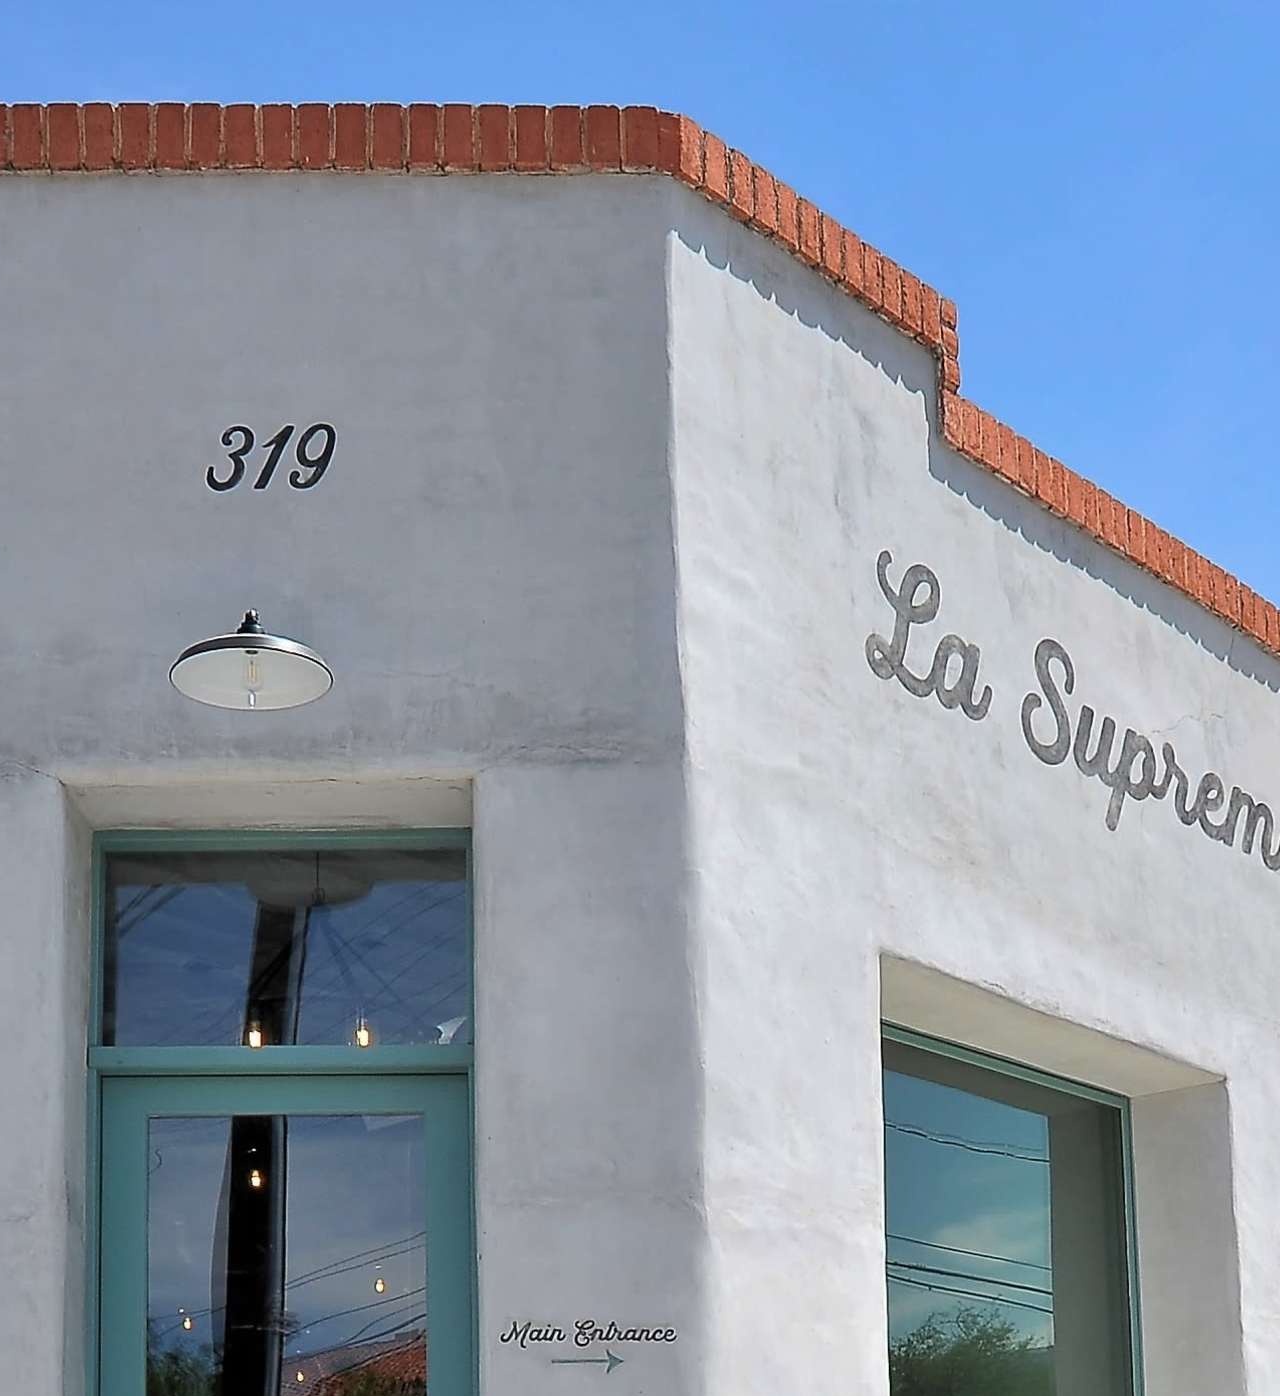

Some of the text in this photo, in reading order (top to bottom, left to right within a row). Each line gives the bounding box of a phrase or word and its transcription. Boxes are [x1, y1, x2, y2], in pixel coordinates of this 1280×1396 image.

[206, 423, 337, 492] 319
[865, 550, 992, 720] La
[500, 1320, 677, 1348] Main Entrance
